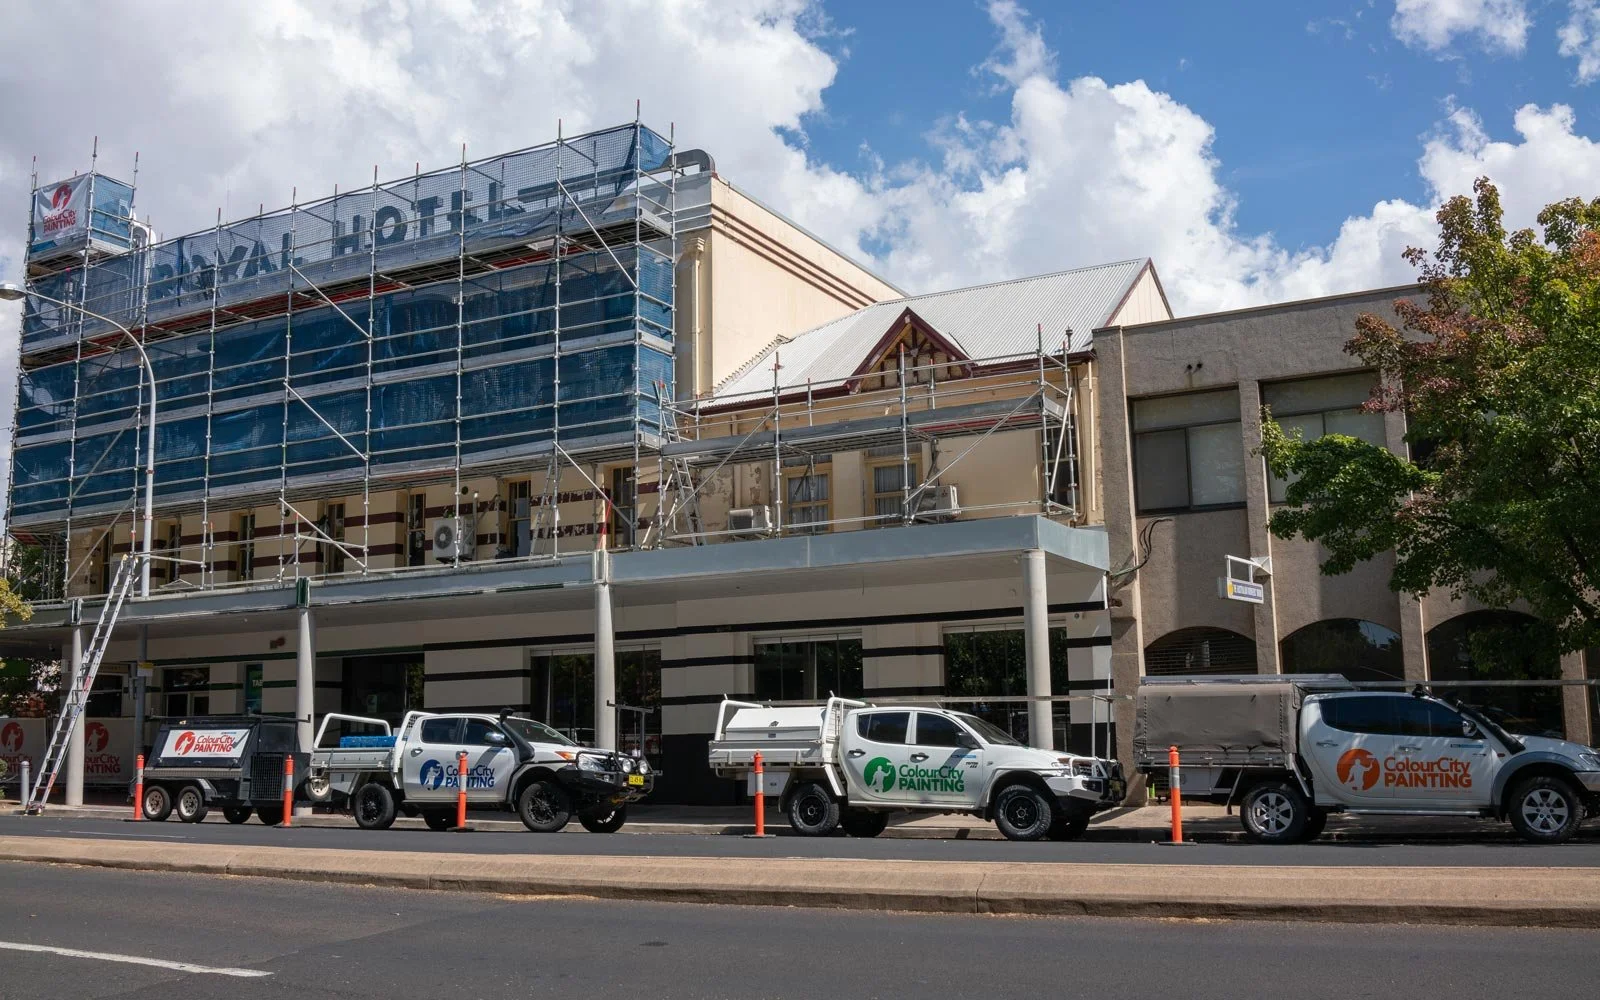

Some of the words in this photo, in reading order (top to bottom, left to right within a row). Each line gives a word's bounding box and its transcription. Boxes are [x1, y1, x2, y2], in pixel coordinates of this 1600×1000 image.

[333, 182, 525, 256] HOTEL
[197, 734, 235, 746] ColourCity
[193, 743, 233, 753] PAINTING
[446, 764, 495, 779] CourCity
[899, 764, 964, 780] ColourCity
[1384, 756, 1471, 776] ColourCity
[898, 777, 964, 792] PAINTING
[1384, 772, 1472, 788] PAINTING
